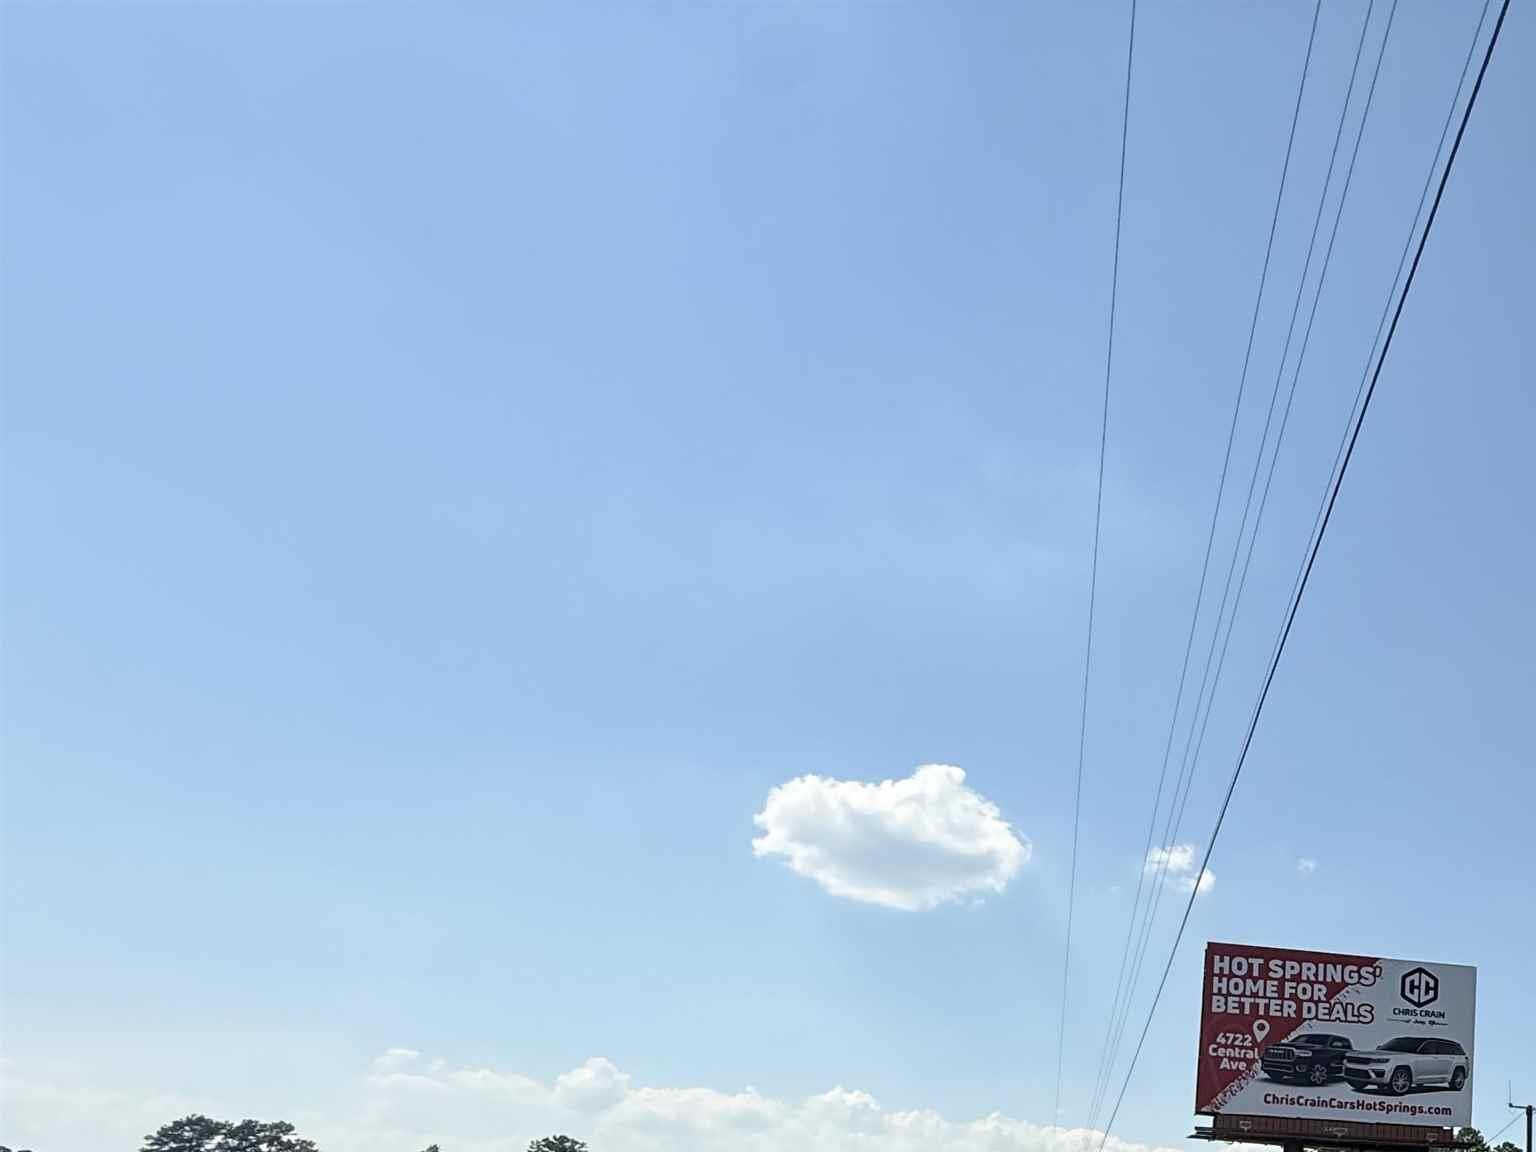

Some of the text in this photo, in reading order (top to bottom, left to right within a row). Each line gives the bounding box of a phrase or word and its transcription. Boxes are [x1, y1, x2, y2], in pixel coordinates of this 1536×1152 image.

[1213, 955, 1382, 987] HOT SPRINGS'
[1212, 976, 1328, 1001] HOME FOR
[1211, 995, 1374, 1024] BETTER DEALS
[1392, 1007, 1446, 1019] CHRIS CRAIN
[1216, 1032, 1253, 1047] 4722
[1208, 1044, 1260, 1059] Central
[1220, 1057, 1247, 1071] Ave
[1263, 1092, 1452, 1116] ChrisCrainCarsHotSprings.com
